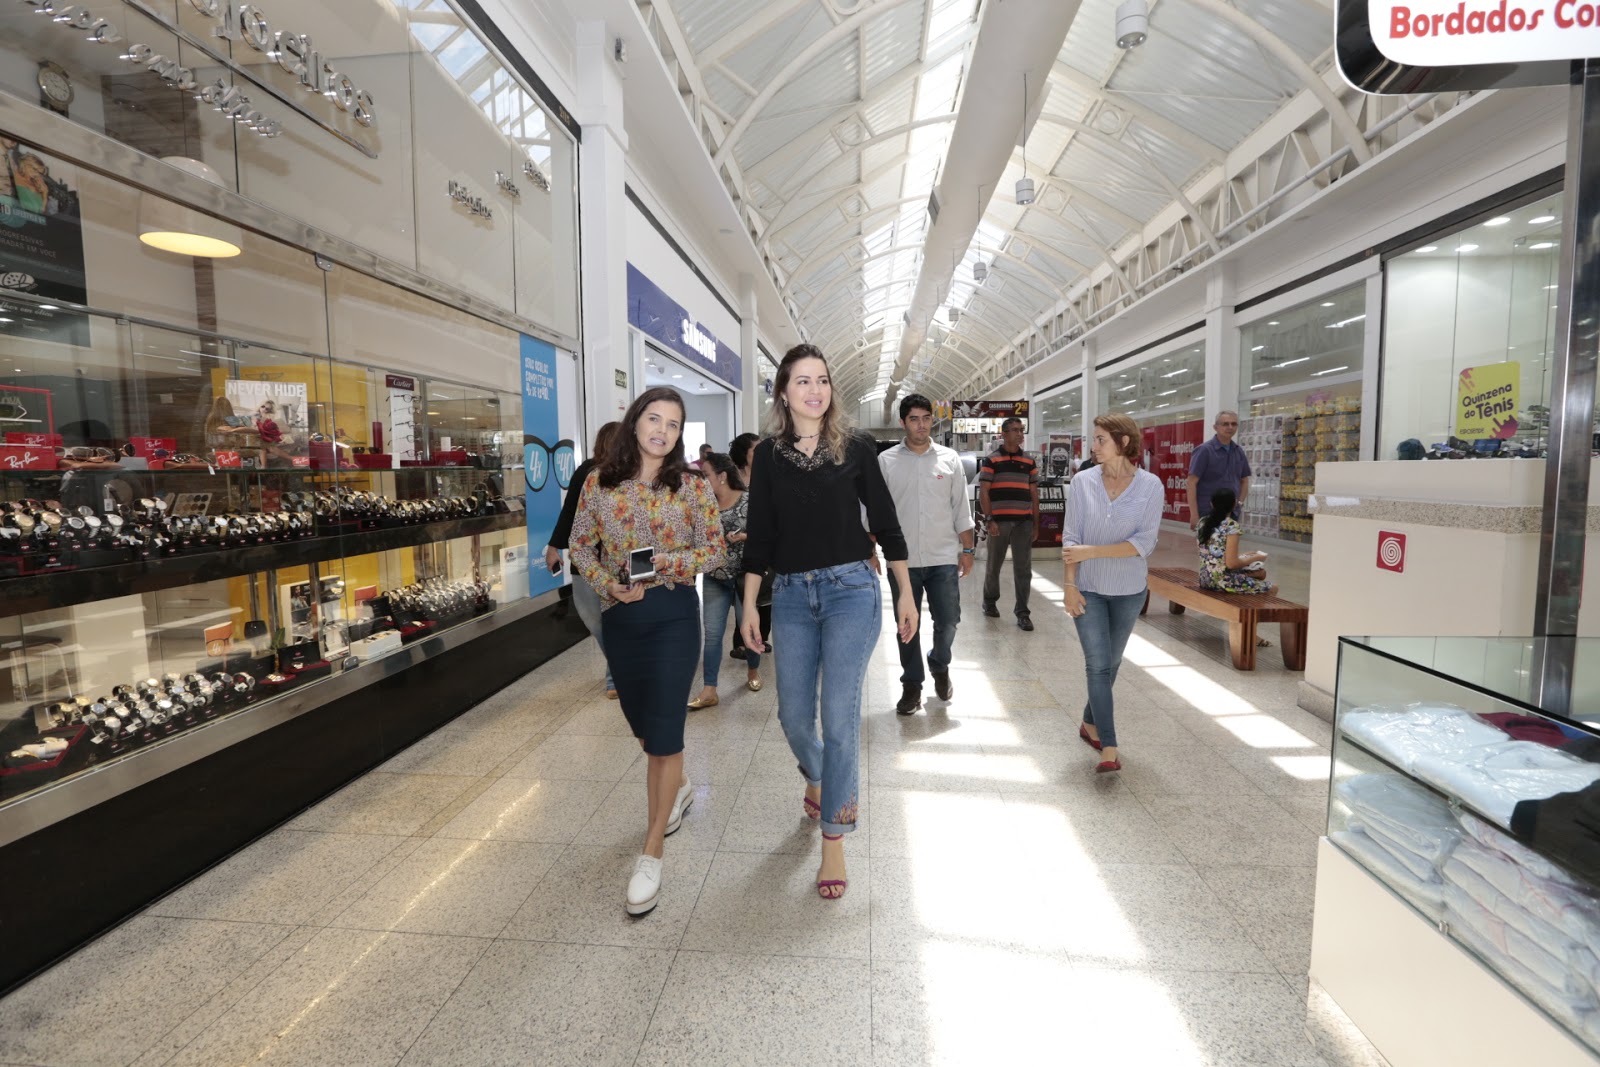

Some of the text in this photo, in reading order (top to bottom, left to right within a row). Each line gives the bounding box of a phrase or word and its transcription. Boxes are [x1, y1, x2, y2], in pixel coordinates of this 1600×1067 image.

[1389, 0, 1600, 39] Bordados Co
[682, 318, 717, 363] SAMSUNG
[228, 382, 304, 397] NEVER HIDE
[1462, 384, 1513, 408] Quinzena
[1464, 397, 1514, 420] do Tênis
[1170, 442, 1195, 455] completa
[4, 452, 39, 468] Ray-Ban
[1167, 475, 1175, 488] do
[1038, 502, 1064, 511] QUINHAS
